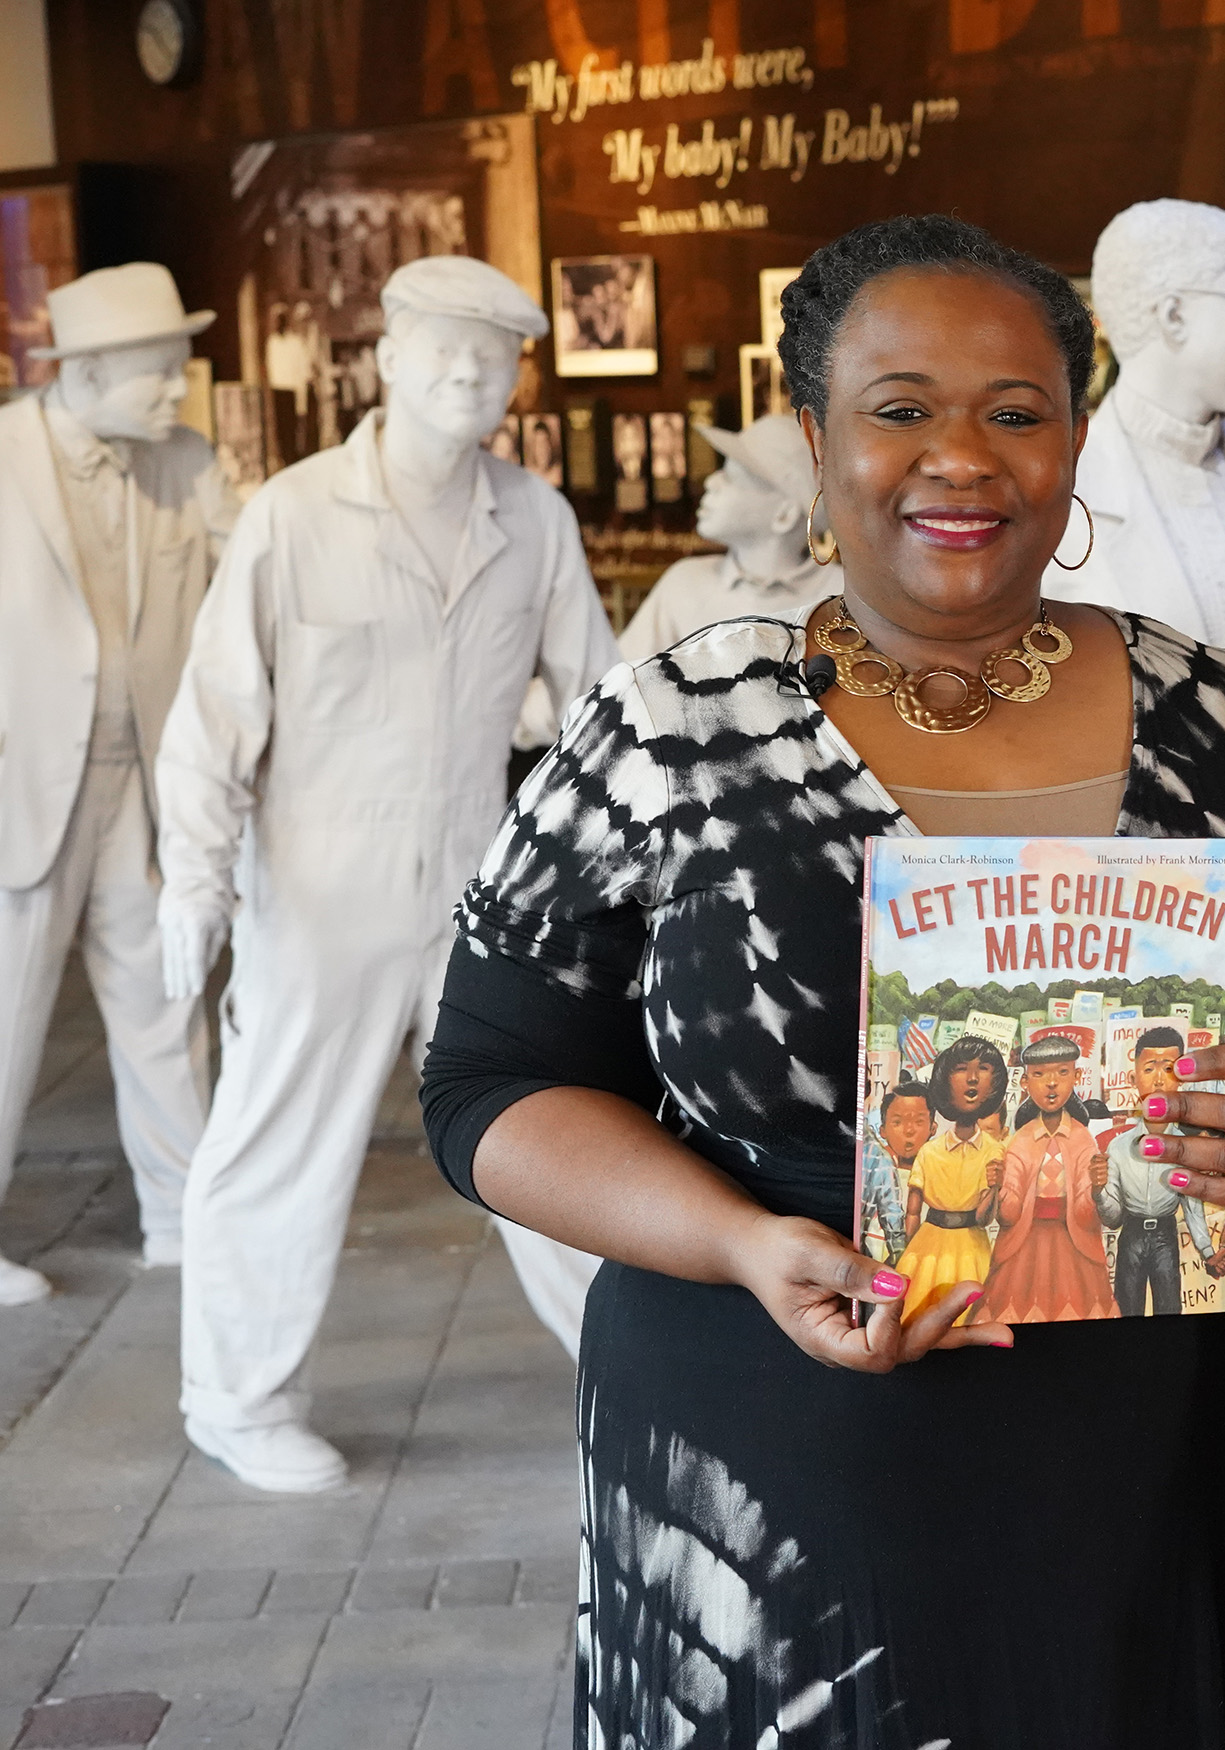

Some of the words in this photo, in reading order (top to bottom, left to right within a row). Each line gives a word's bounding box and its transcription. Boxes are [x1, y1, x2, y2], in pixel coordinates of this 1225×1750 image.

[571, 53, 633, 122] first
[640, 38, 727, 100] words
[732, 46, 814, 90] were,
[664, 118, 752, 189] baby!
[760, 113, 815, 182] My
[901, 854, 937, 865] Monica
[939, 854, 1014, 865] Clark-Robinson
[1097, 854, 1143, 865] Illustrated
[1146, 854, 1156, 867] by
[1160, 854, 1186, 865] Frank
[888, 883, 956, 940] LET
[966, 873, 1040, 920] THE
[984, 922, 1133, 973] MARCH
[972, 1016, 987, 1027] NO
[858, 1049, 866, 1065] THE
[856, 1067, 865, 1109] CHILDREN
[856, 1111, 864, 1141] MARCH
